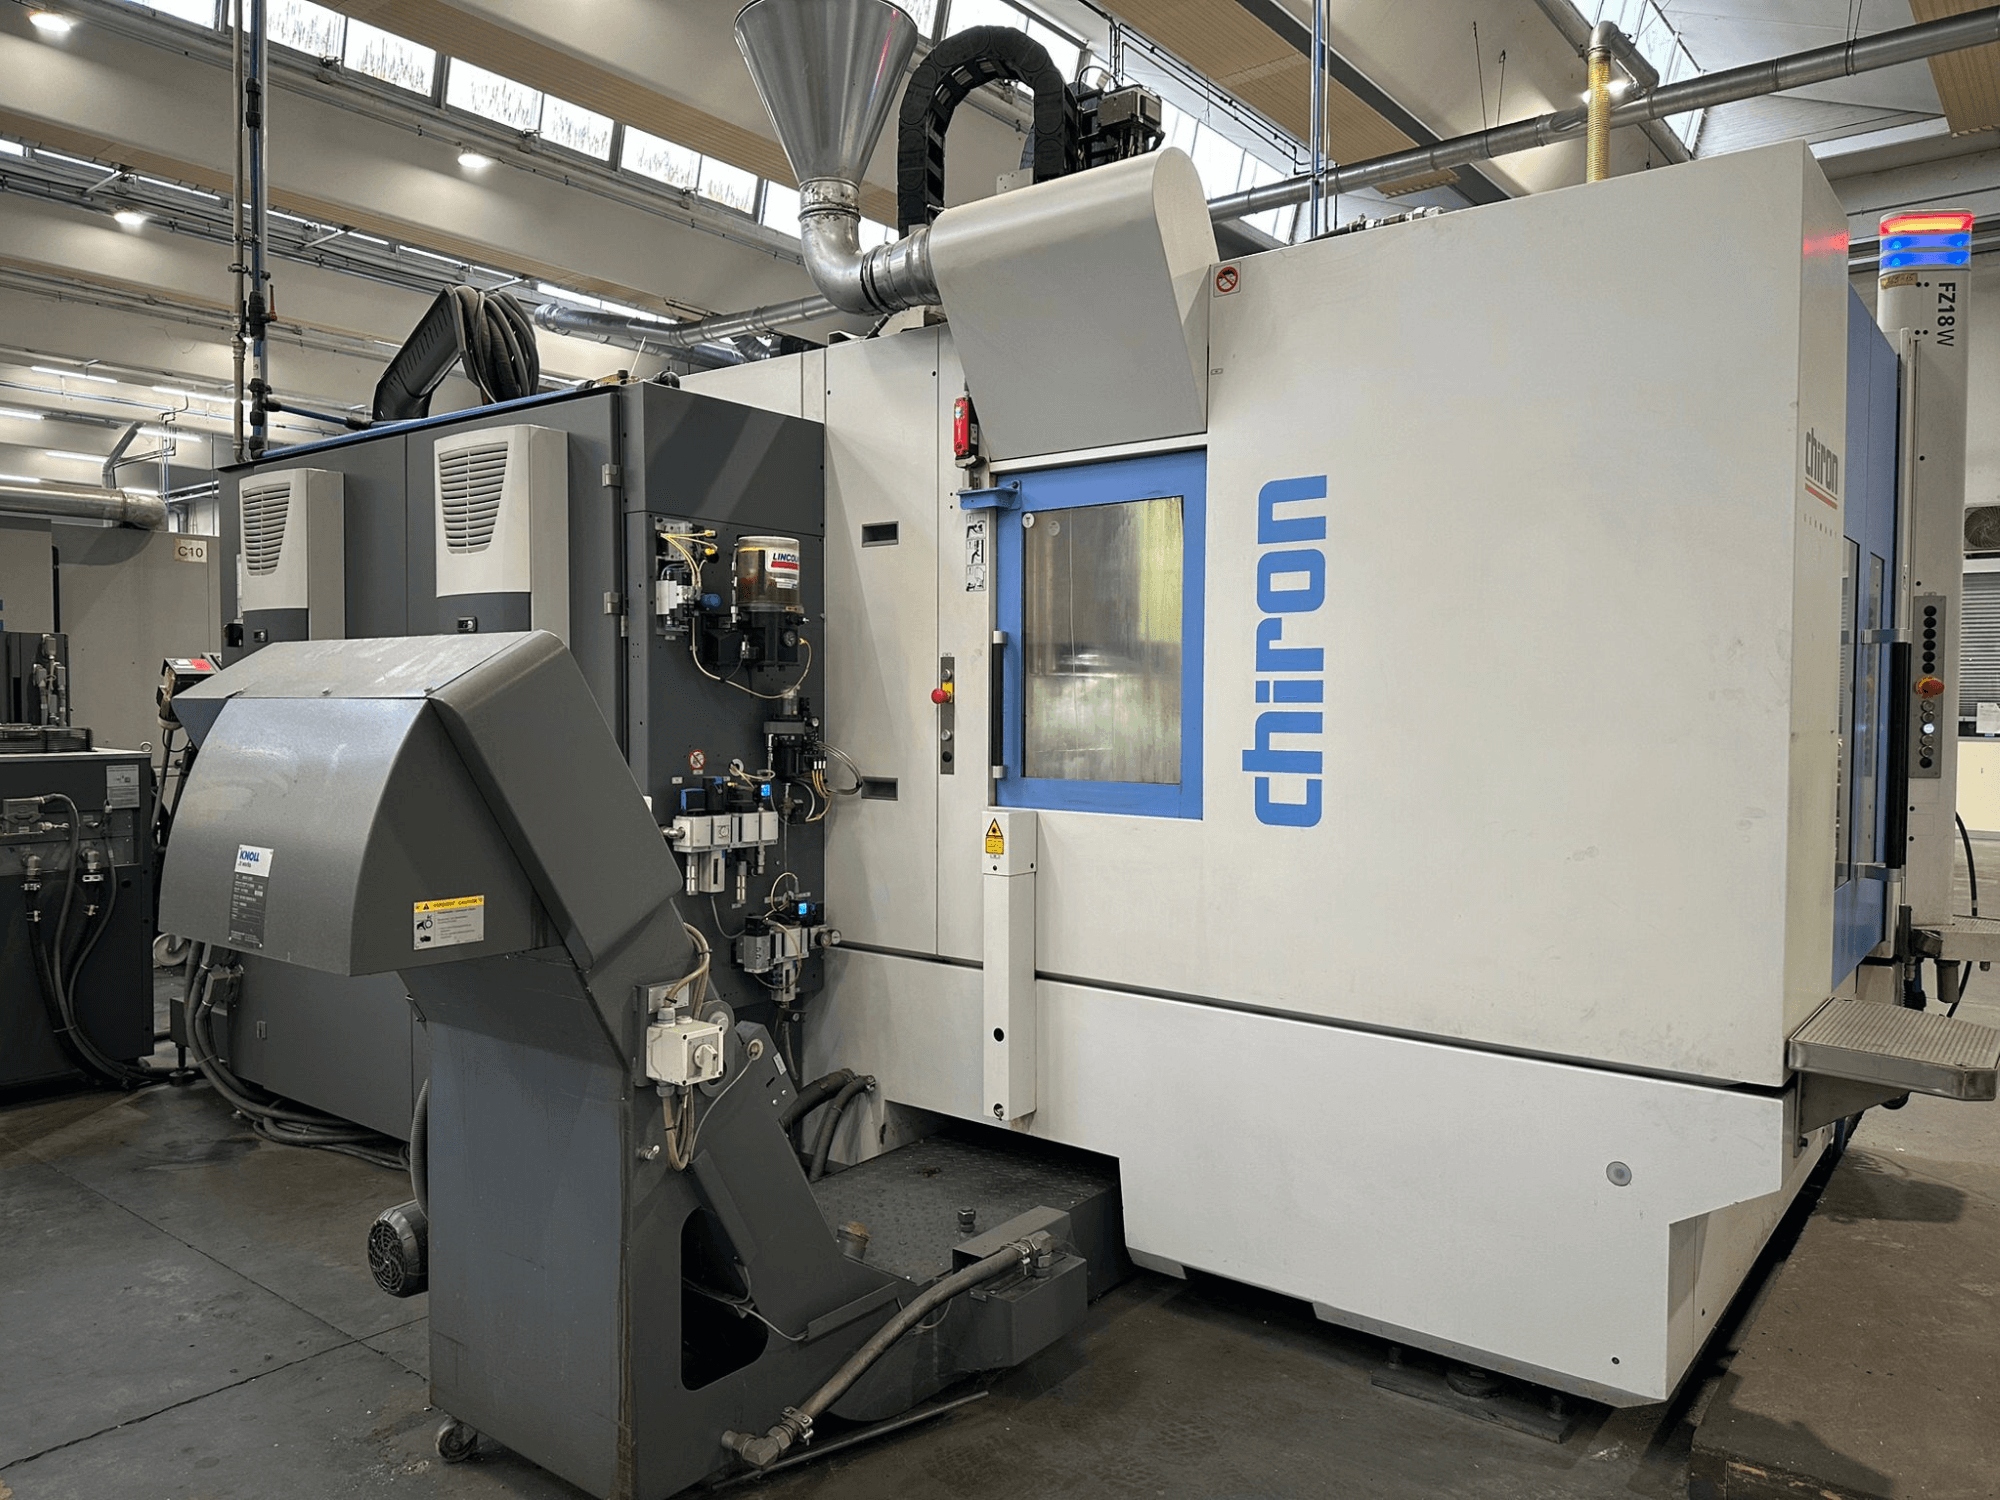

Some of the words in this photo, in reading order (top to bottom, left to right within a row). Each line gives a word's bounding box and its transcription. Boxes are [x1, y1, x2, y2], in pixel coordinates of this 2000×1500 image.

[1805, 427, 1838, 495] chiron
[178, 546, 203, 558] C10
[1242, 475, 1328, 828] chiron
[239, 850, 260, 862] KNOLL
